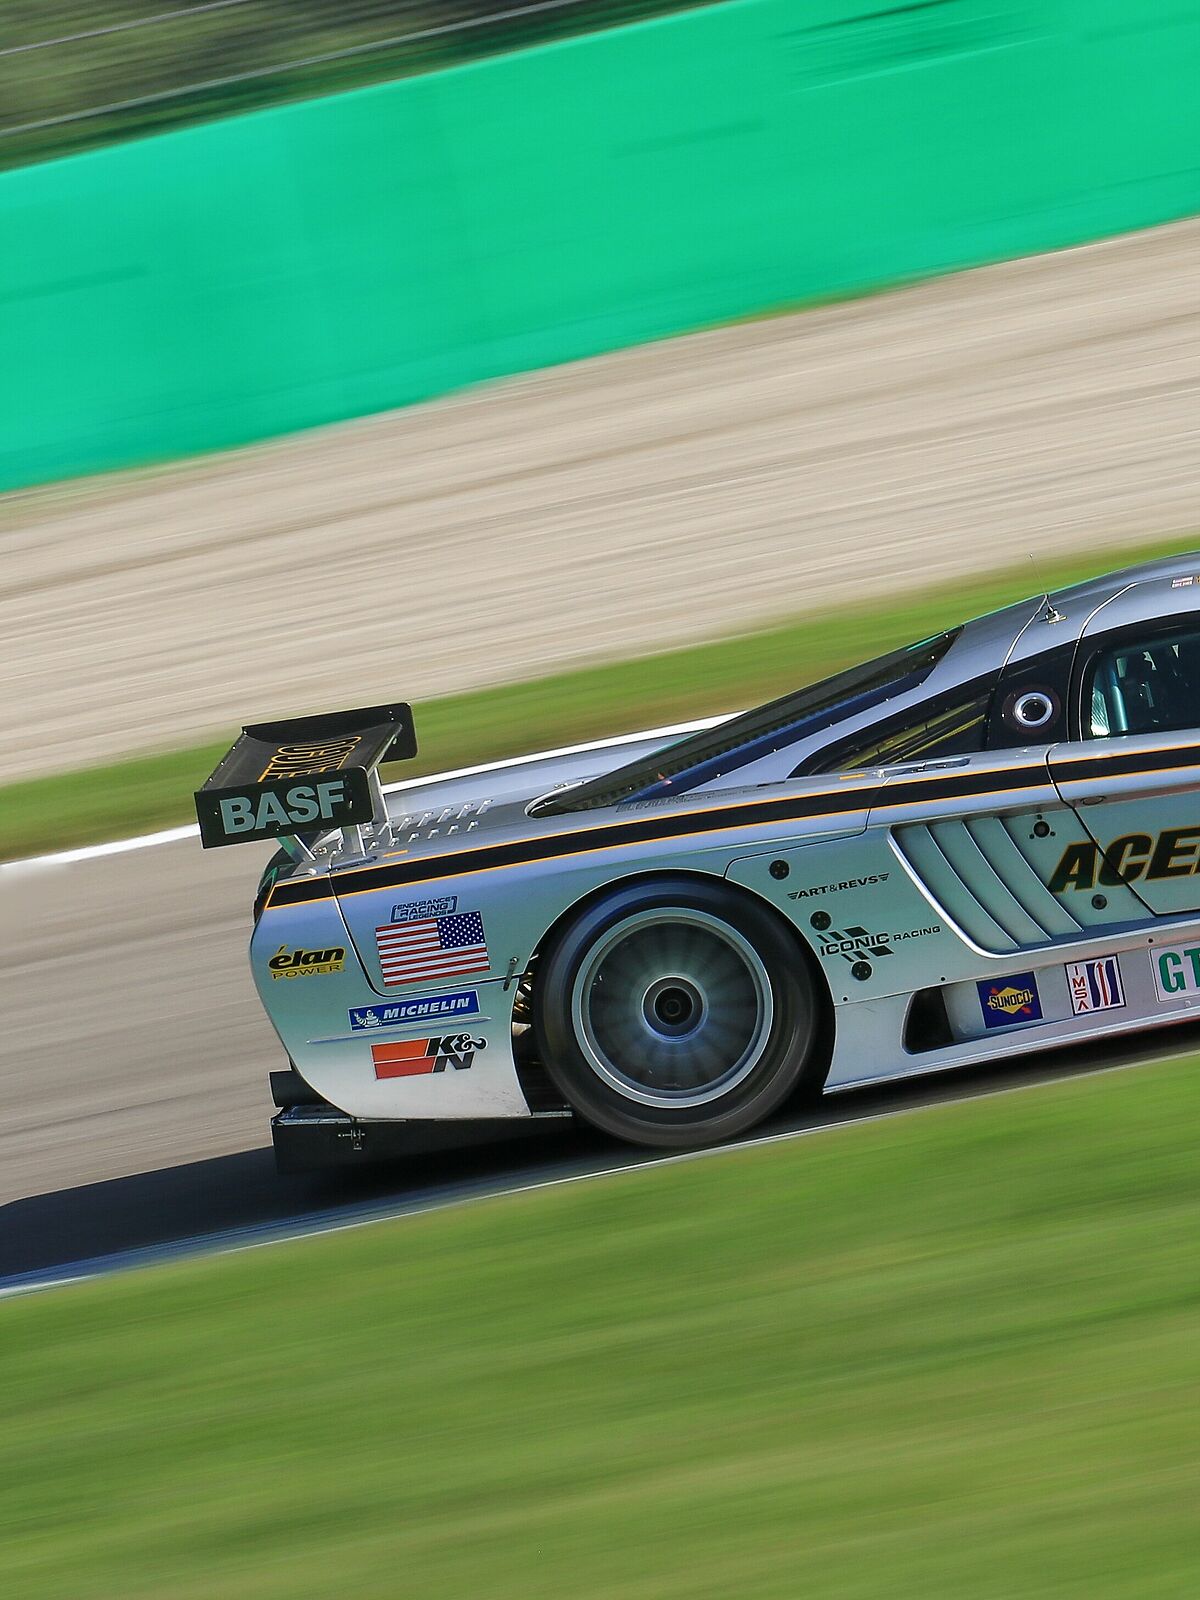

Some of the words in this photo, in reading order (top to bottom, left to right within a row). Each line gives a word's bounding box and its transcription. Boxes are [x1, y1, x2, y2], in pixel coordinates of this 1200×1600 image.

[219, 780, 345, 836] BASF
[797, 875, 879, 899] ART&REVS
[397, 896, 452, 910] ENDURANCE
[400, 903, 449, 917] RACING
[820, 932, 890, 957] ICONIC
[893, 925, 942, 942] RACING
[268, 945, 345, 970] élan
[273, 965, 341, 980] POWER
[990, 990, 1031, 1009] SUNOCO
[1072, 965, 1089, 1012] IMSA
[383, 997, 470, 1020] MICHELIN
